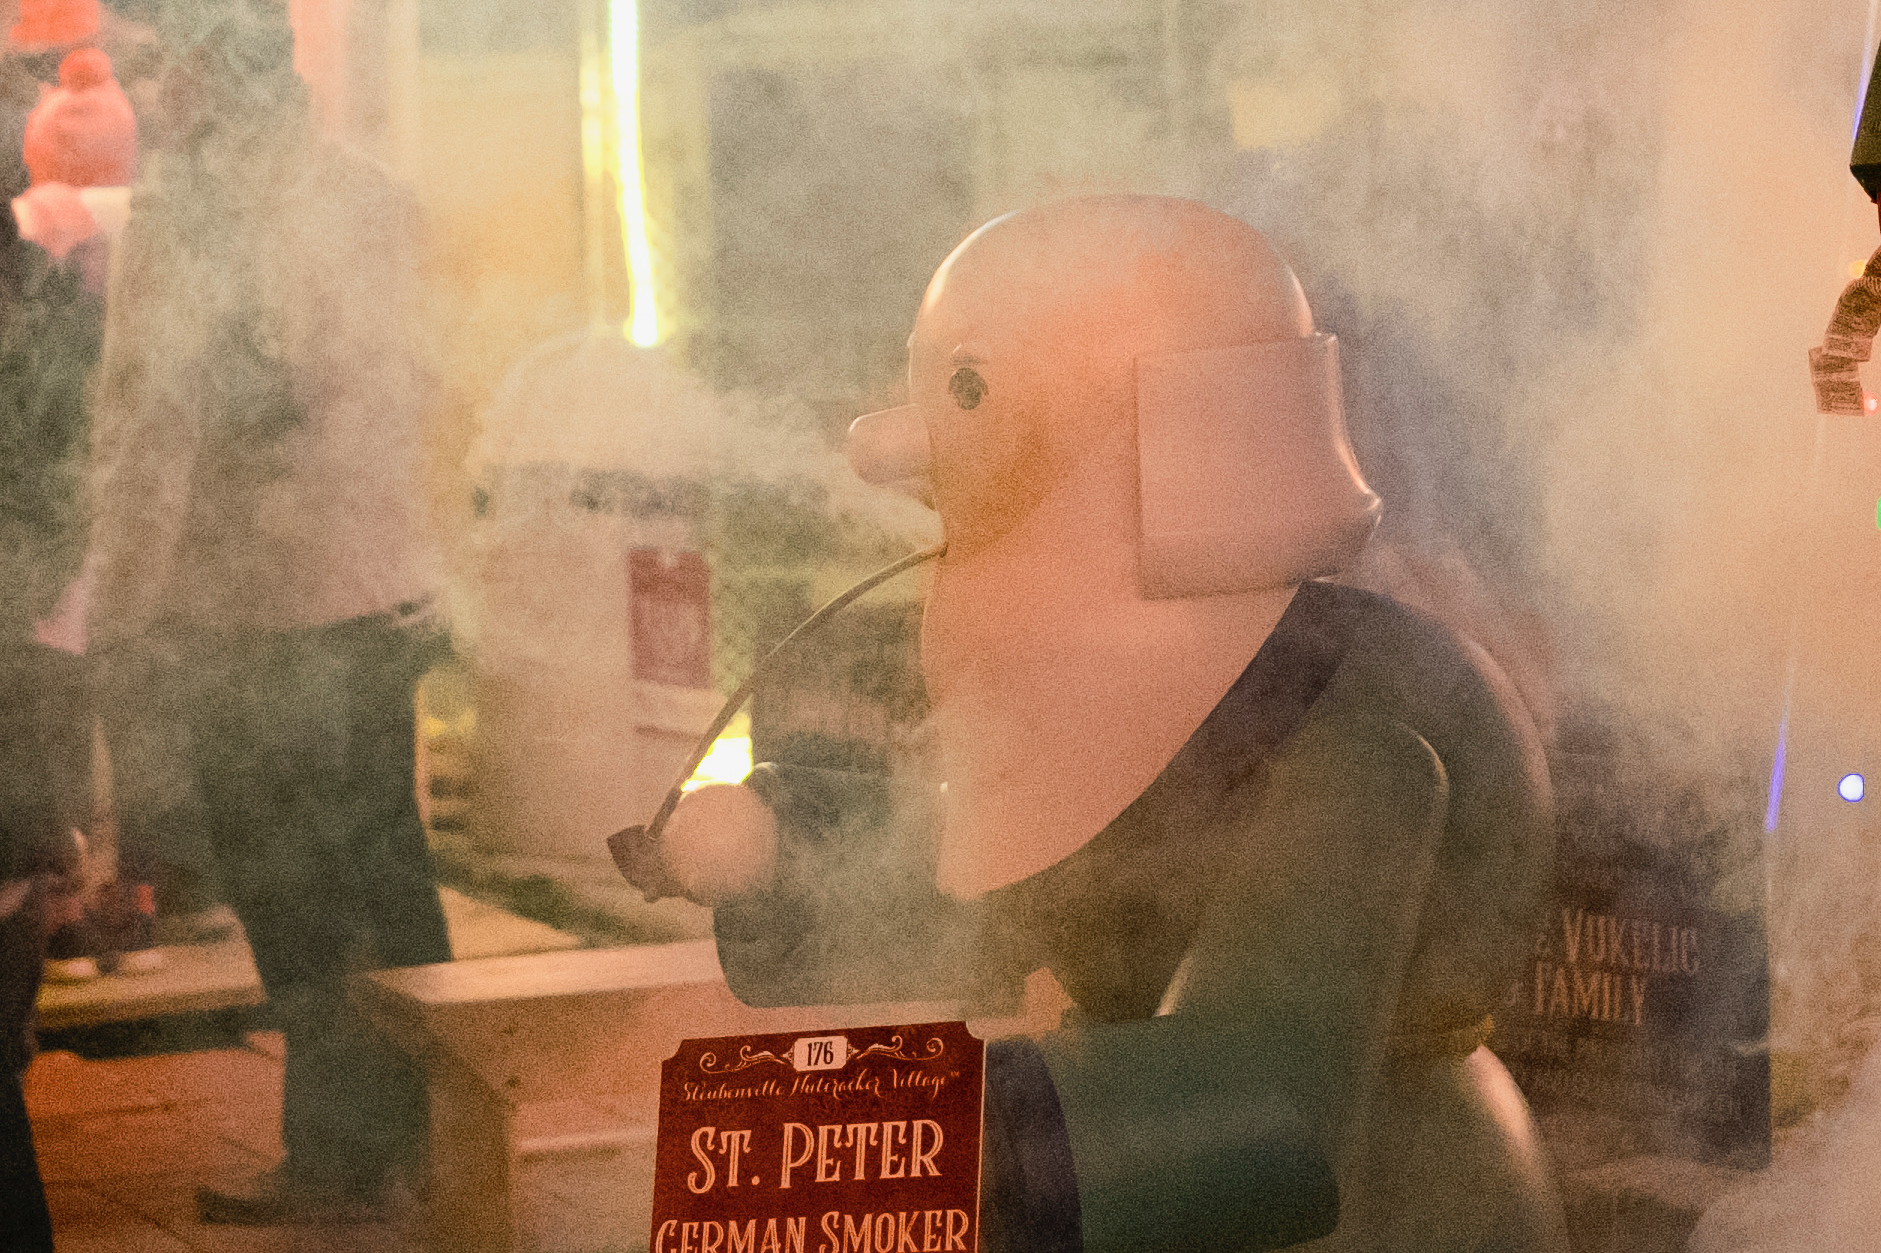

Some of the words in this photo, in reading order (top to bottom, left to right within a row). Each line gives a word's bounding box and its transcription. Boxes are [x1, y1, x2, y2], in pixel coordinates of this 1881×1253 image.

[1535, 960, 1648, 1027] FAMILY
[806, 1040, 835, 1067] 176
[686, 1125, 761, 1195] ST.
[778, 1118, 944, 1189] PETER
[654, 1216, 807, 1253] GERMAN
[818, 1208, 969, 1253] SMOKER
